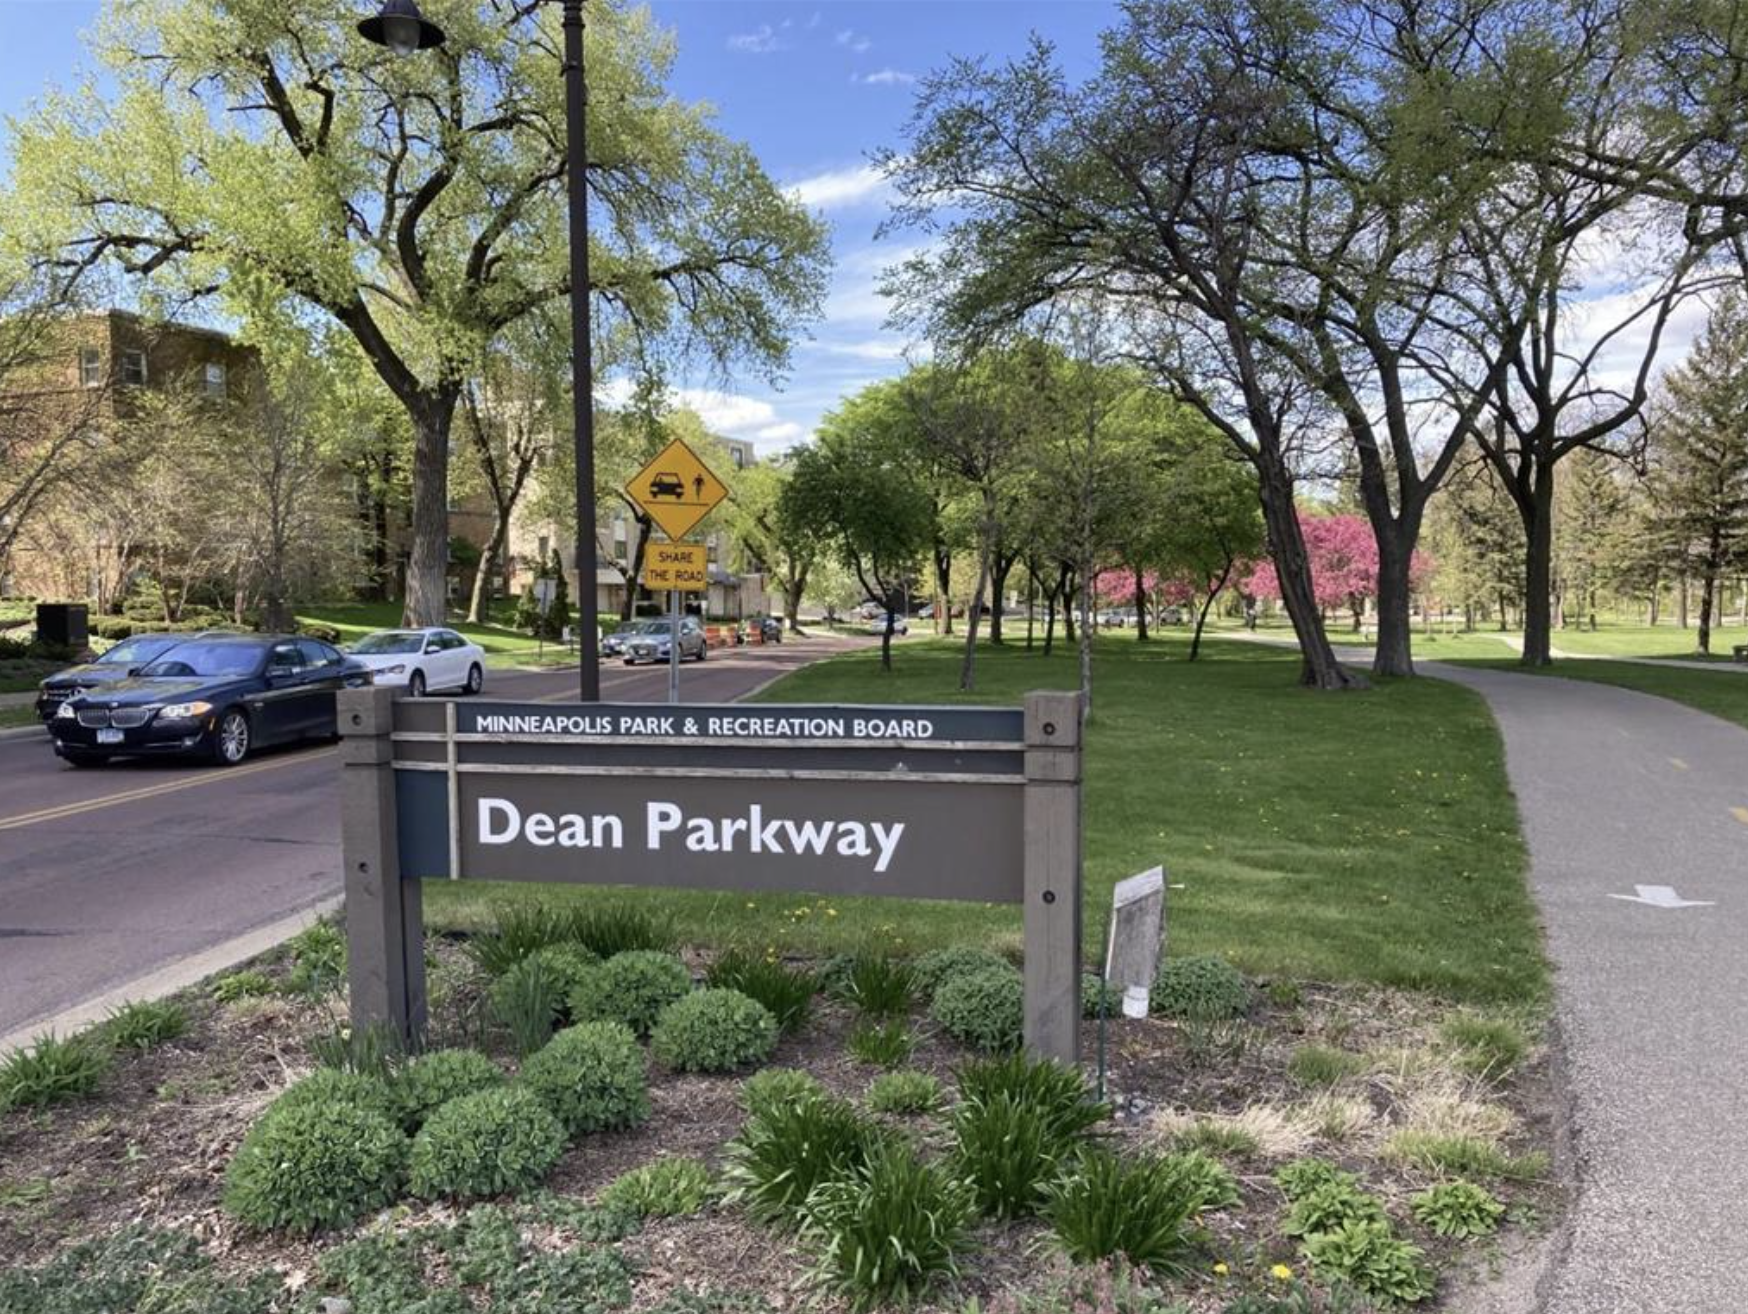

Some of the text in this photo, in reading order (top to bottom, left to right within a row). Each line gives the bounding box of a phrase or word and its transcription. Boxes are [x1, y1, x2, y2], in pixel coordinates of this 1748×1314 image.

[659, 551, 693, 563] SHARE
[650, 569, 704, 582] THE ROAD
[476, 715, 934, 738] MINNEAPOLIS PARK & RECREATION BOARD
[478, 797, 906, 873] Dean Parkway
